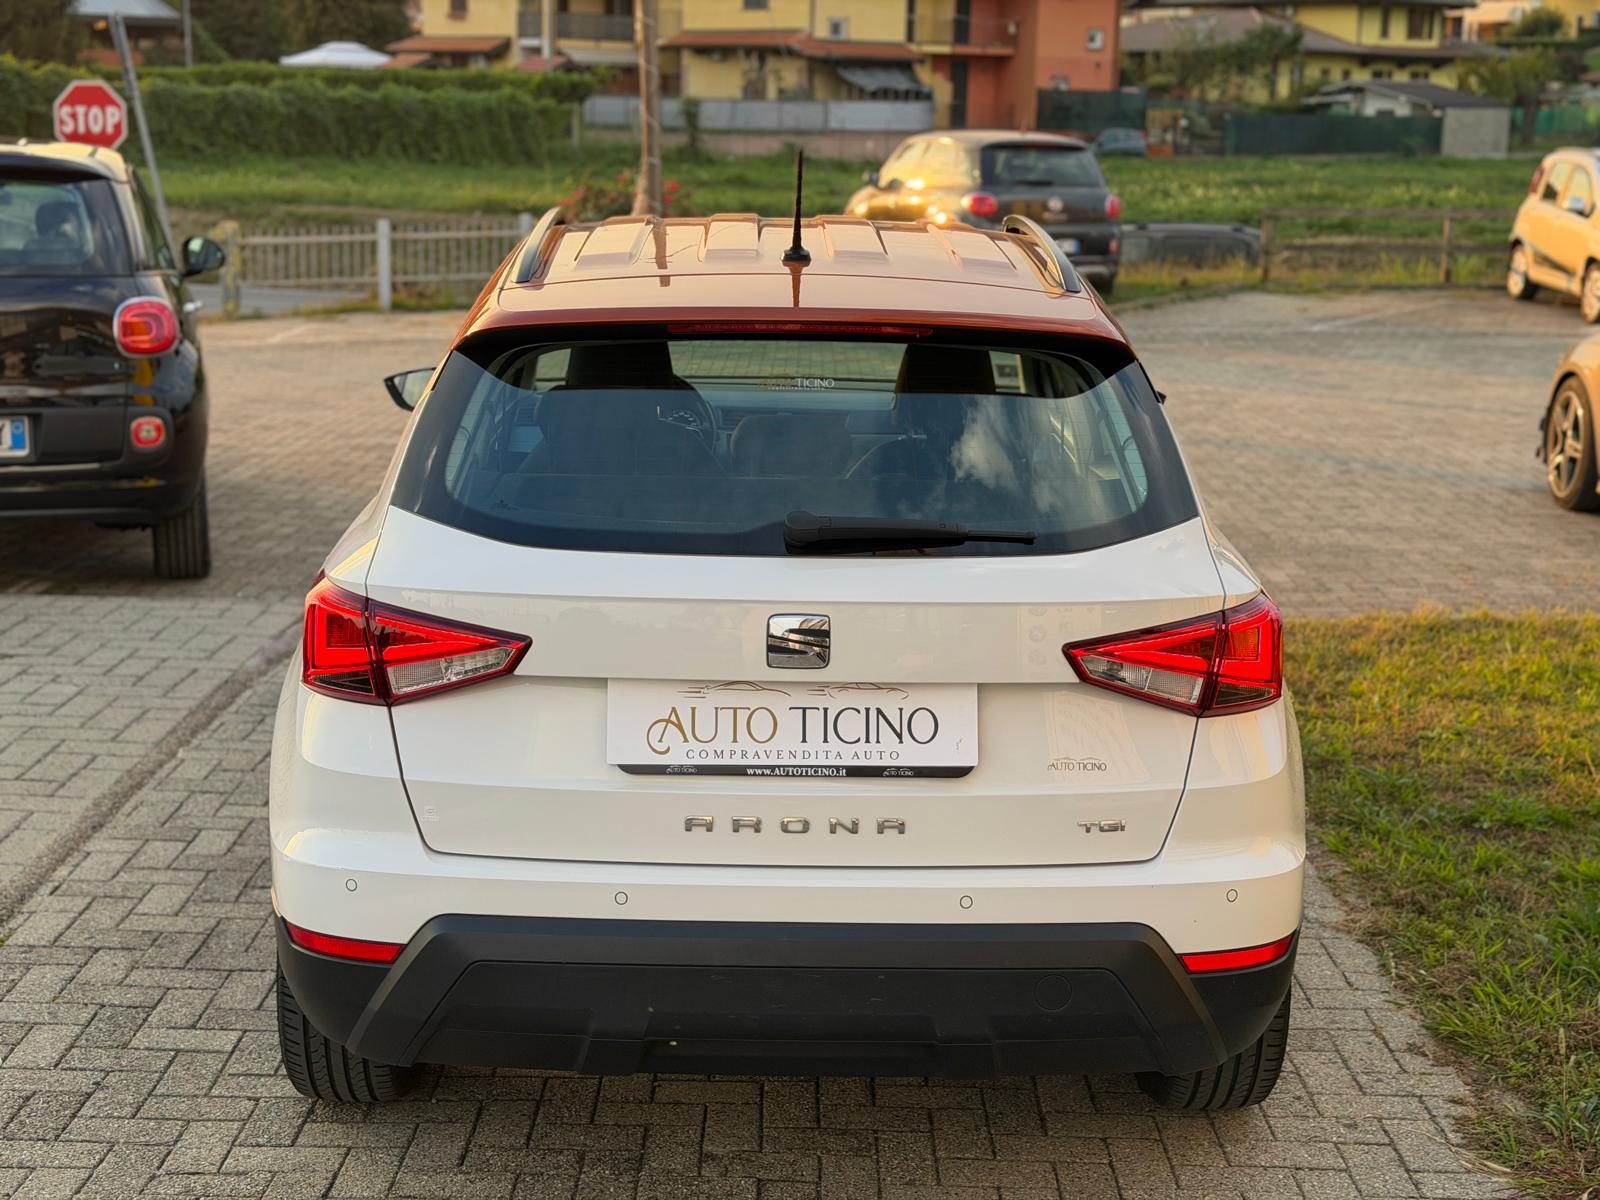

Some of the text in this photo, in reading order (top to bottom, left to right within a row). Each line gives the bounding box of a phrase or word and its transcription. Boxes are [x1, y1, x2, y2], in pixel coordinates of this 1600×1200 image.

[60, 104, 121, 135] STOP
[797, 378, 835, 388] TICINO
[646, 706, 939, 755] AUTO TICINO
[686, 749, 900, 761] COMPRAVENDITA AUTO
[746, 766, 848, 777] www.AUTOTICINO.it
[1047, 761, 1107, 772] AUTO TICINO
[684, 815, 906, 834] ARONA
[1077, 820, 1126, 833] TGI
